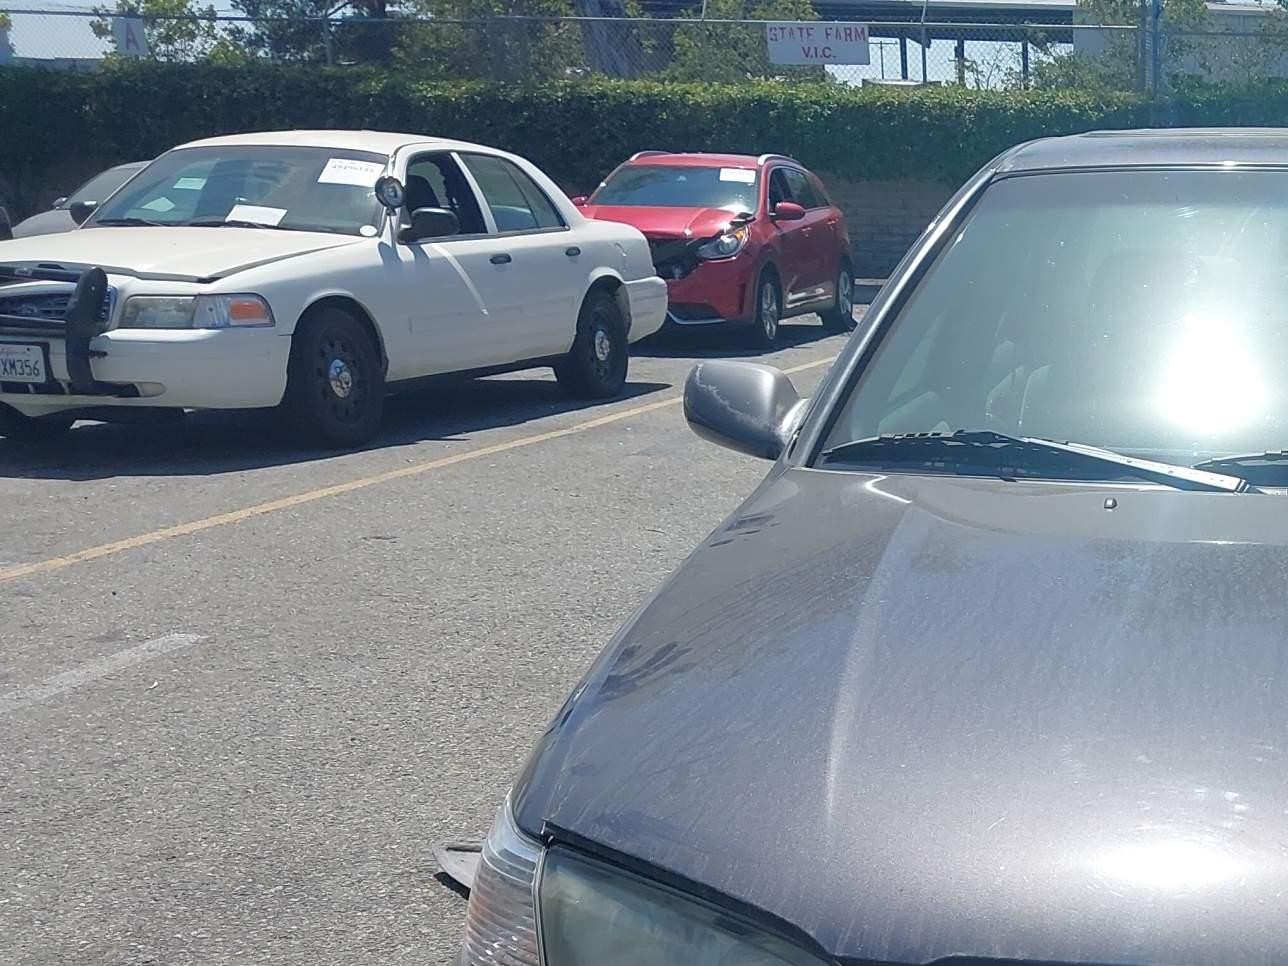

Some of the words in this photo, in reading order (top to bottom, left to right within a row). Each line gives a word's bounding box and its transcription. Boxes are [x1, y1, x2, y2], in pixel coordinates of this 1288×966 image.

[125, 22, 140, 50] A
[768, 26, 815, 41] STATE
[824, 26, 866, 41] FARM
[801, 46, 837, 59] V.I.C.
